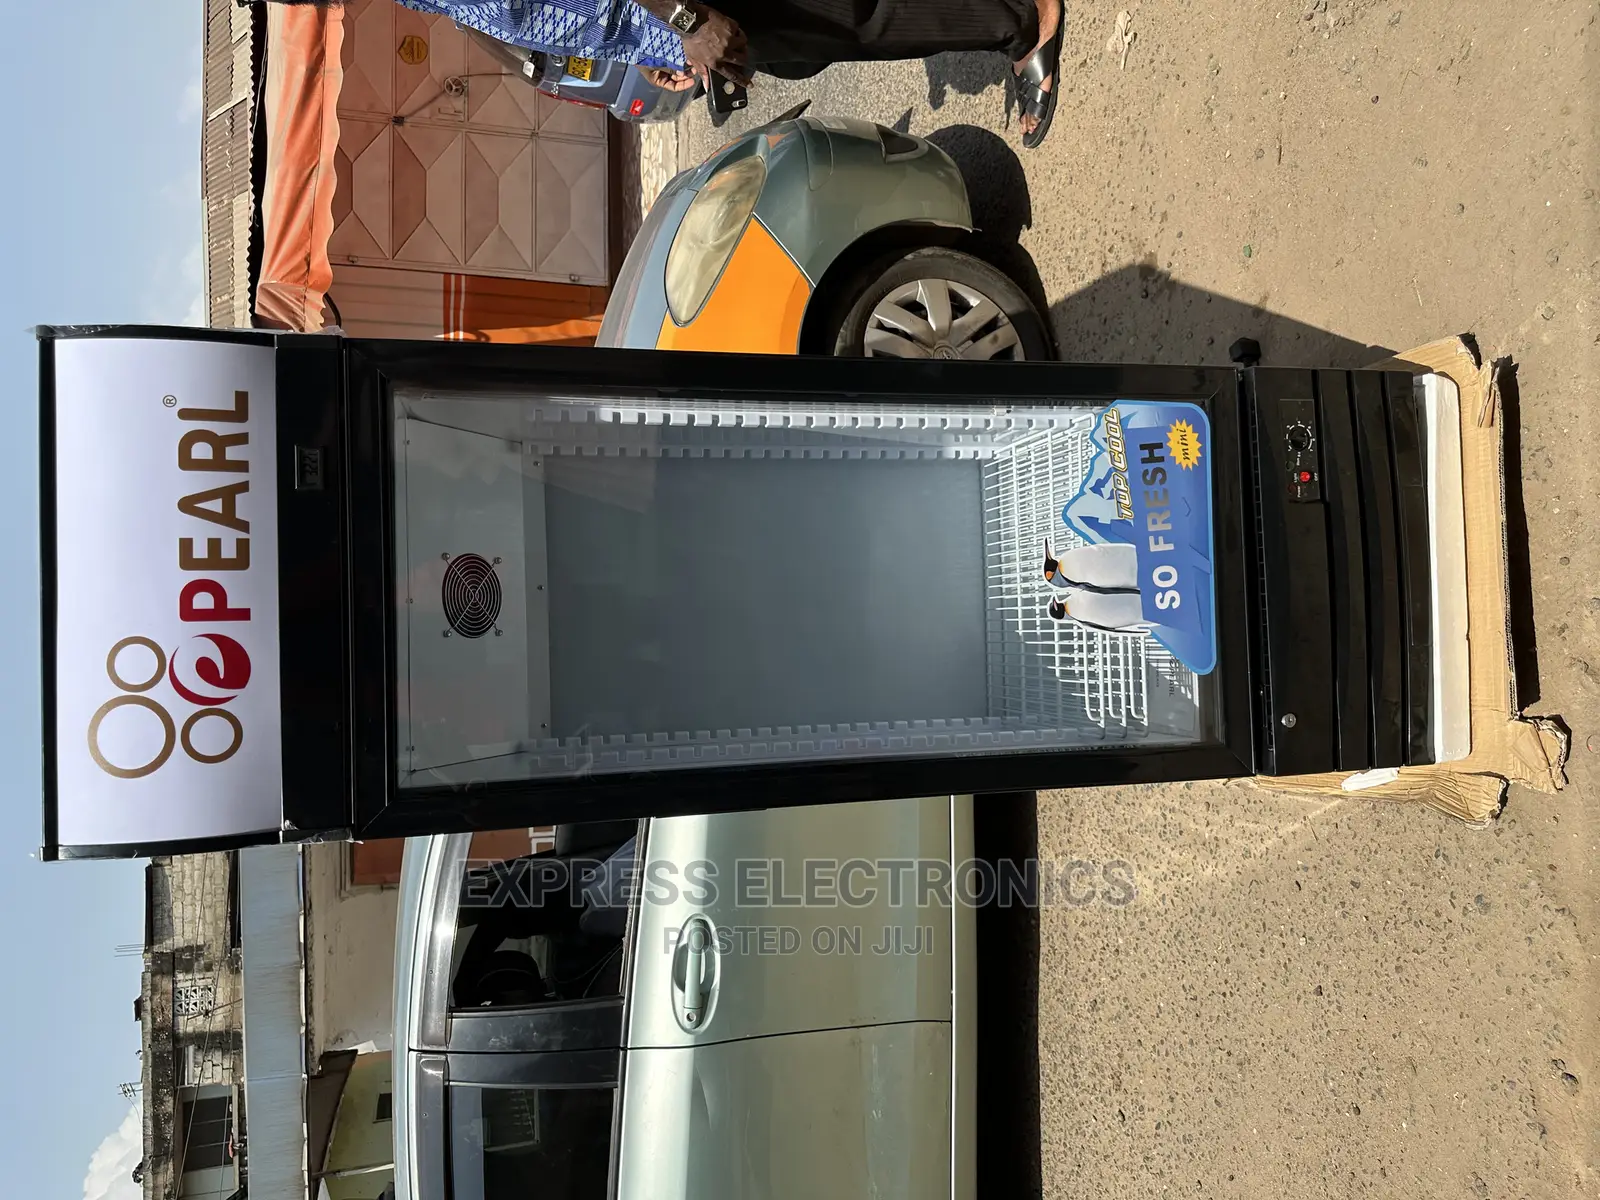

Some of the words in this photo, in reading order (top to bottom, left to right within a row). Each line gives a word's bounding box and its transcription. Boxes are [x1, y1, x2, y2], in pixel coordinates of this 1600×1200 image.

[1104, 407, 1128, 472] COOL
[1176, 427, 1191, 461] mini
[177, 390, 251, 622] PEARL
[1113, 472, 1135, 520] TOP
[1139, 442, 1175, 553] FRESH
[1152, 565, 1181, 610] SO
